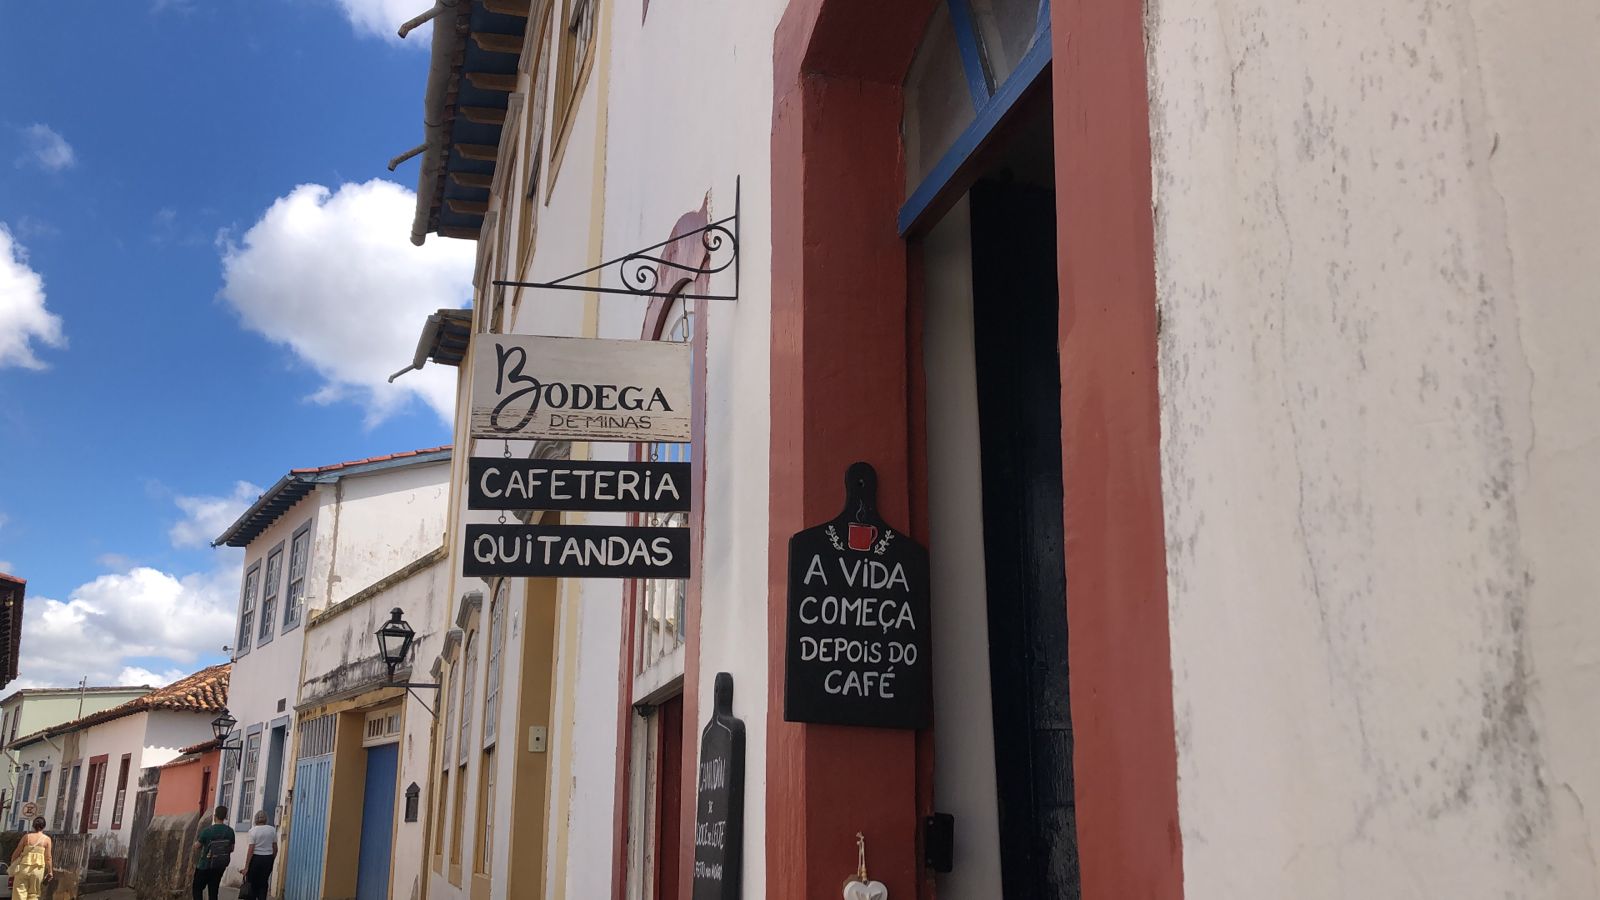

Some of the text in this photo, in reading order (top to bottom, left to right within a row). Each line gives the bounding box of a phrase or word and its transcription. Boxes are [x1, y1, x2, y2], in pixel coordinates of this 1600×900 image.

[490, 342, 674, 433] BODEGA
[549, 413, 652, 429] DE MINAS
[803, 553, 828, 586] A
[799, 596, 915, 634] COMEÇA
[888, 641, 918, 666] DO
[824, 666, 896, 699] CAFÉ
